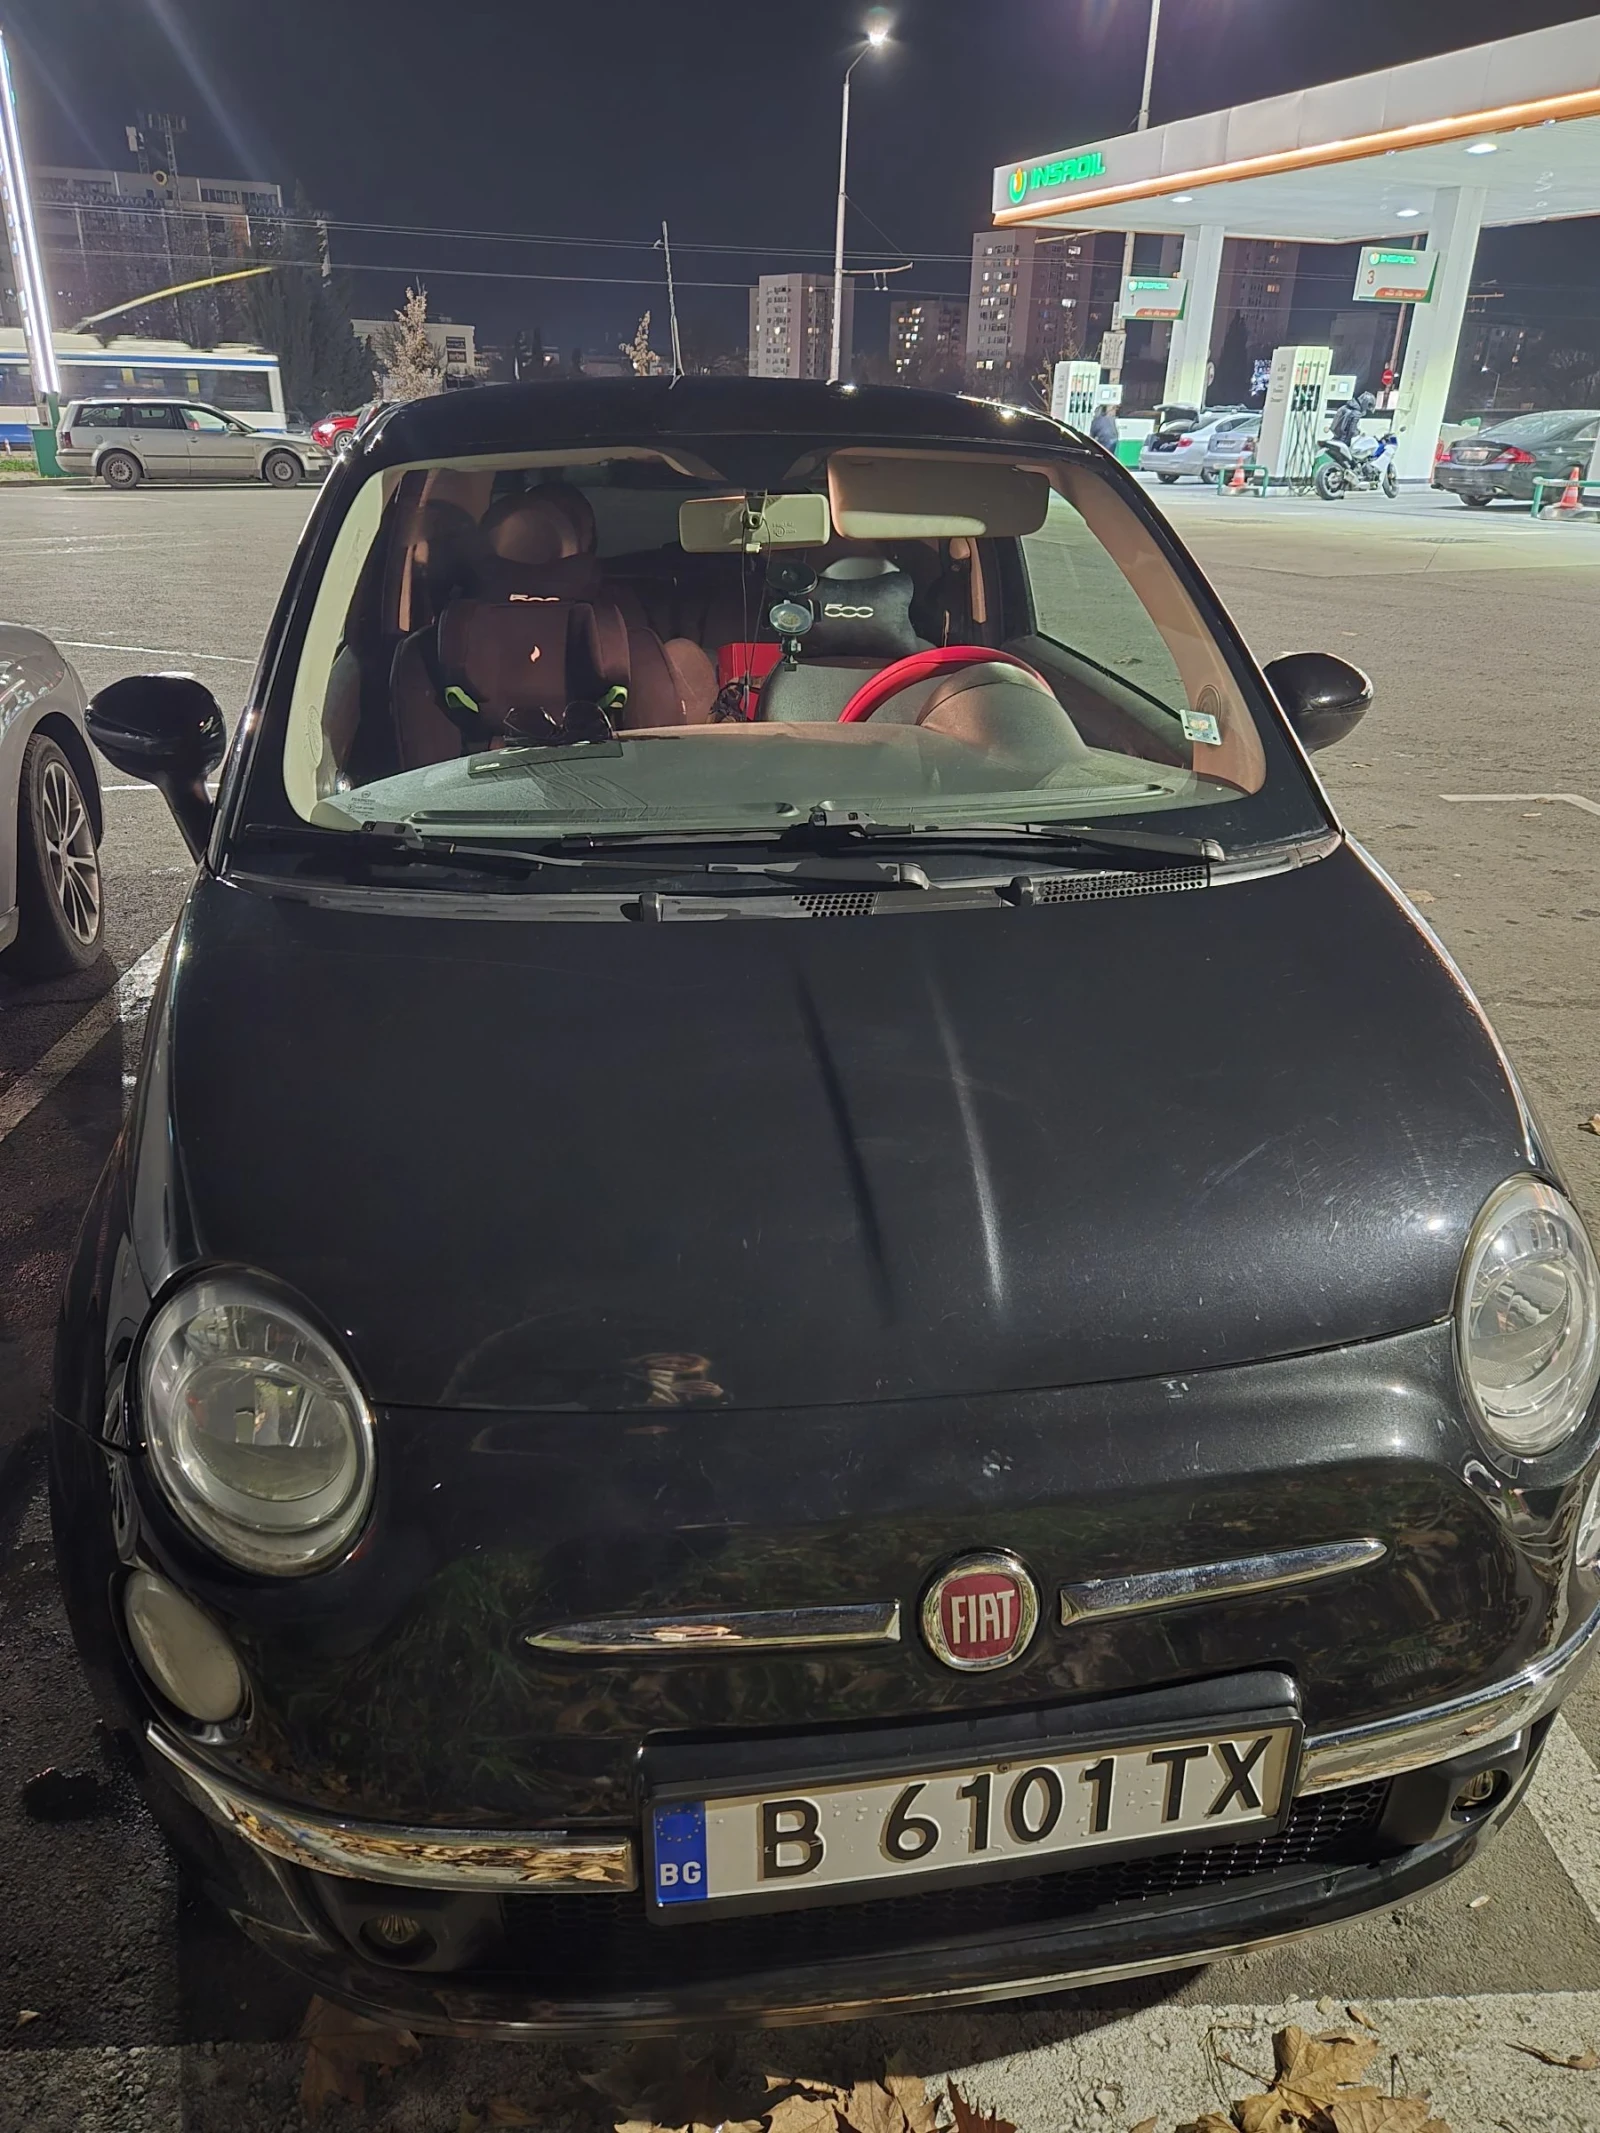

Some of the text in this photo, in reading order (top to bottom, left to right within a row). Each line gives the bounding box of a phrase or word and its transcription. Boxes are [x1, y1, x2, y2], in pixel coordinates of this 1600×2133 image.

[1030, 152, 1106, 189] INSAOIL
[1366, 269, 1376, 285] 3
[824, 603, 874, 618] 500
[951, 1589, 1016, 1645] FIAT
[762, 1735, 1273, 1880] B 6101 TX
[659, 1861, 702, 1887] BG
